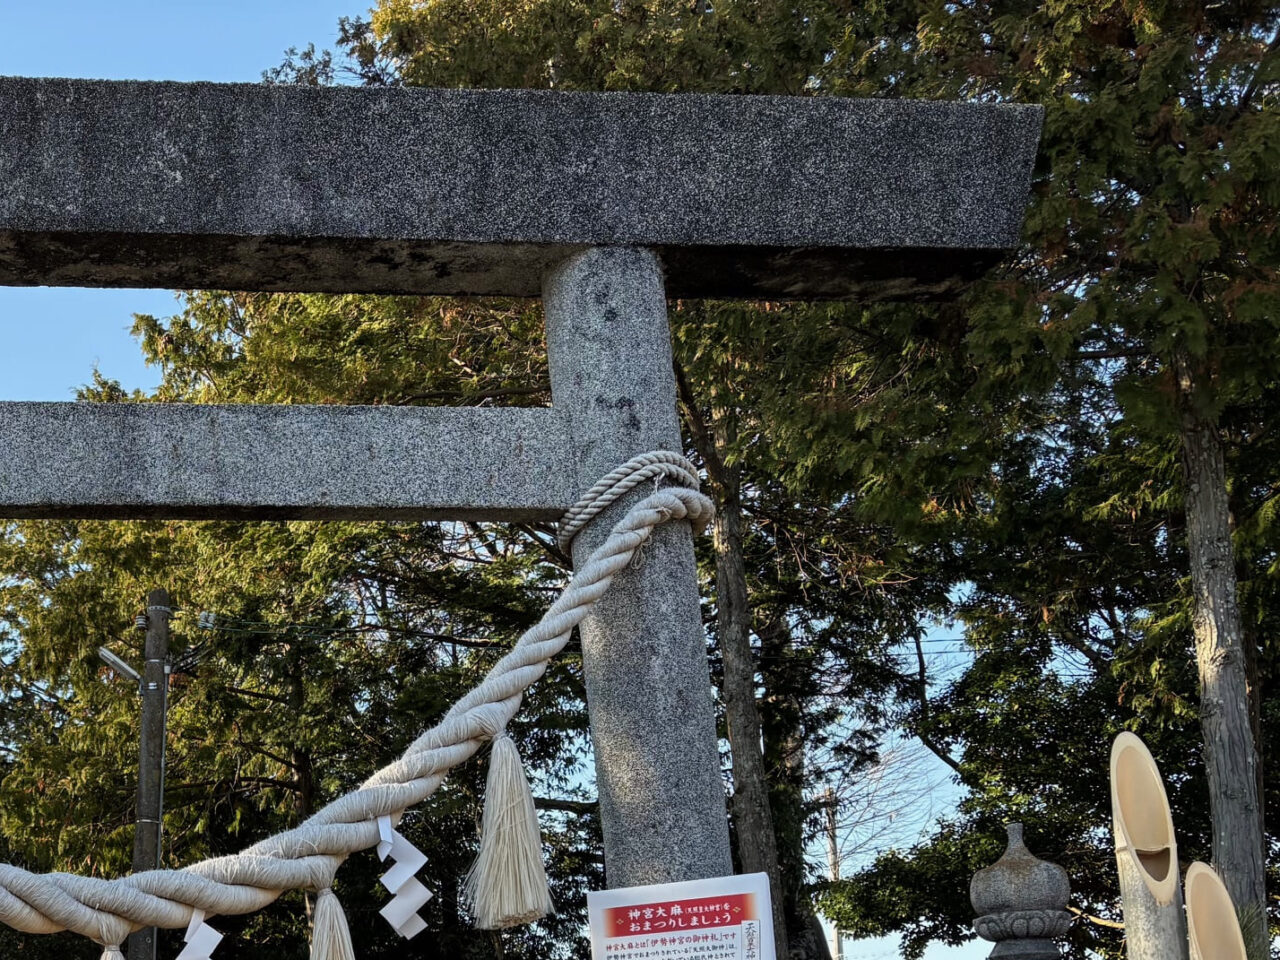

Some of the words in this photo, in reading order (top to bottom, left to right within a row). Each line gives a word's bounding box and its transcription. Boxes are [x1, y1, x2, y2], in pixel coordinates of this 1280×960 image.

[629, 913, 731, 932] おまつりしましょう
